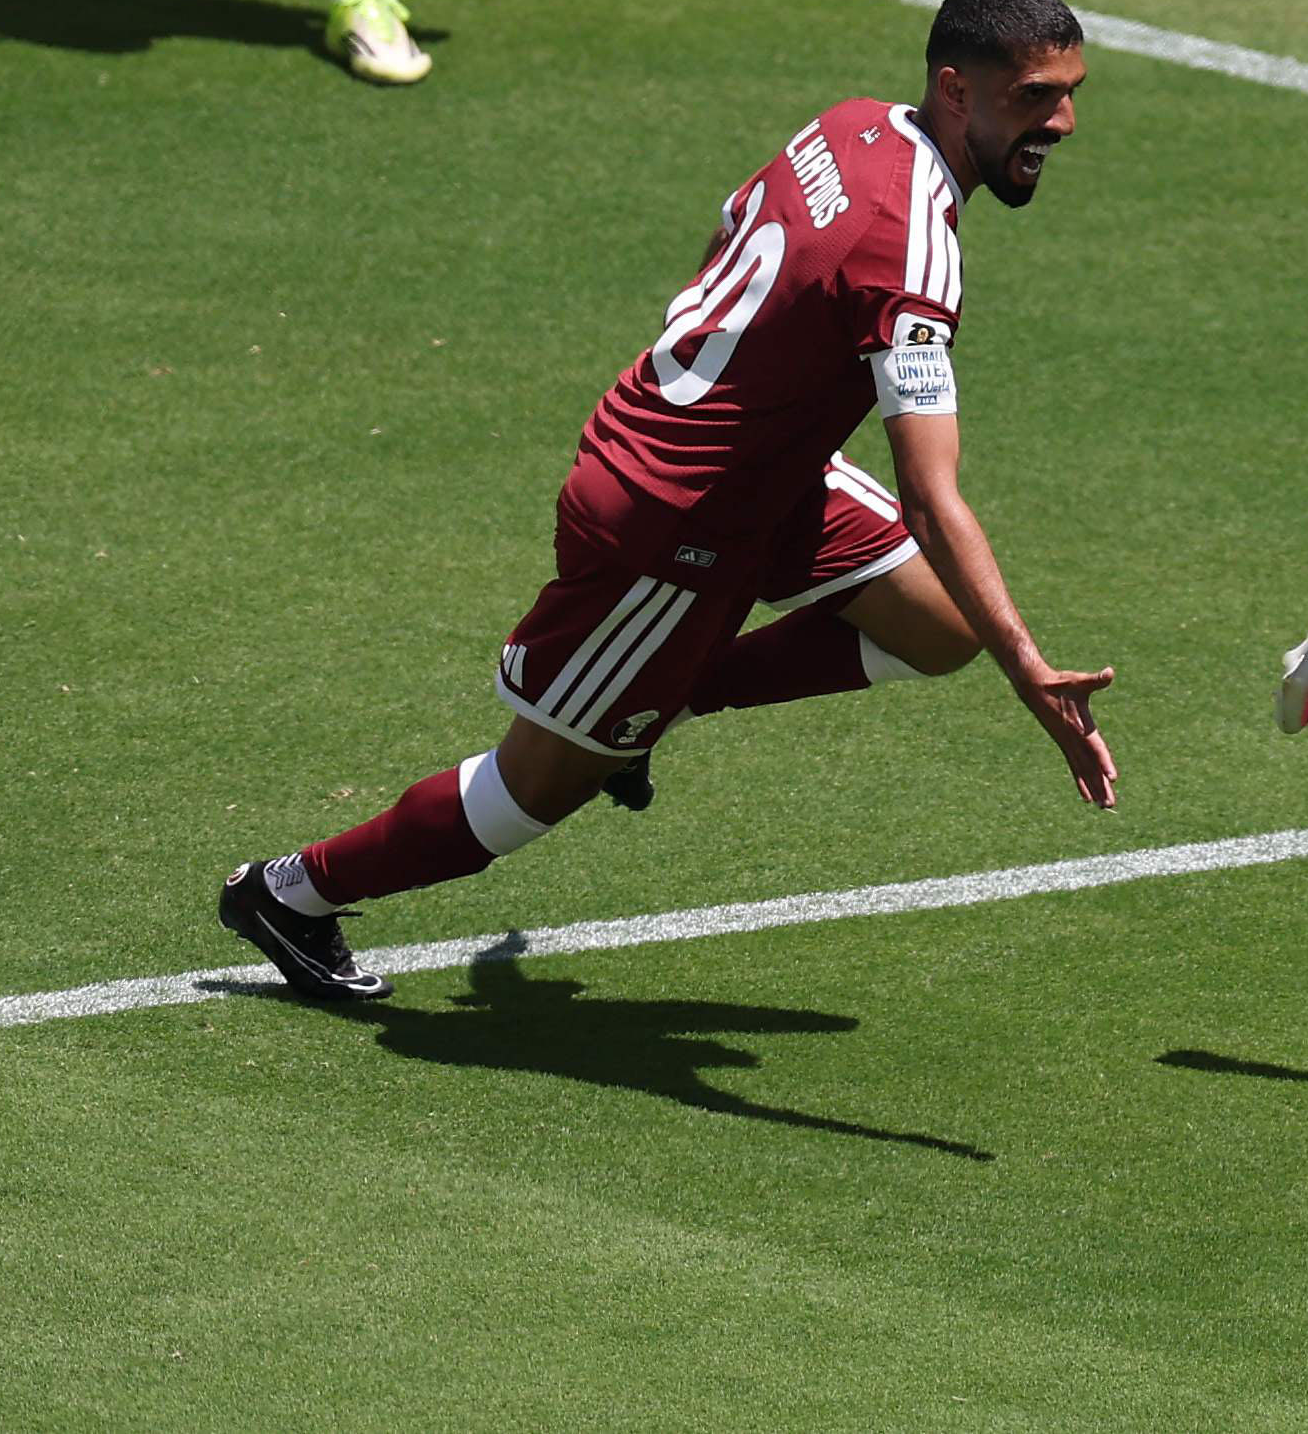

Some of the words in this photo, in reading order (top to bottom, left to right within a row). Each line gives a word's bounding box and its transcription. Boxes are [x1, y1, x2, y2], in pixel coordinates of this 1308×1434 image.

[786, 118, 850, 229] LHAYDOS
[652, 180, 786, 406] 10
[896, 351, 943, 364] FOOTBALL
